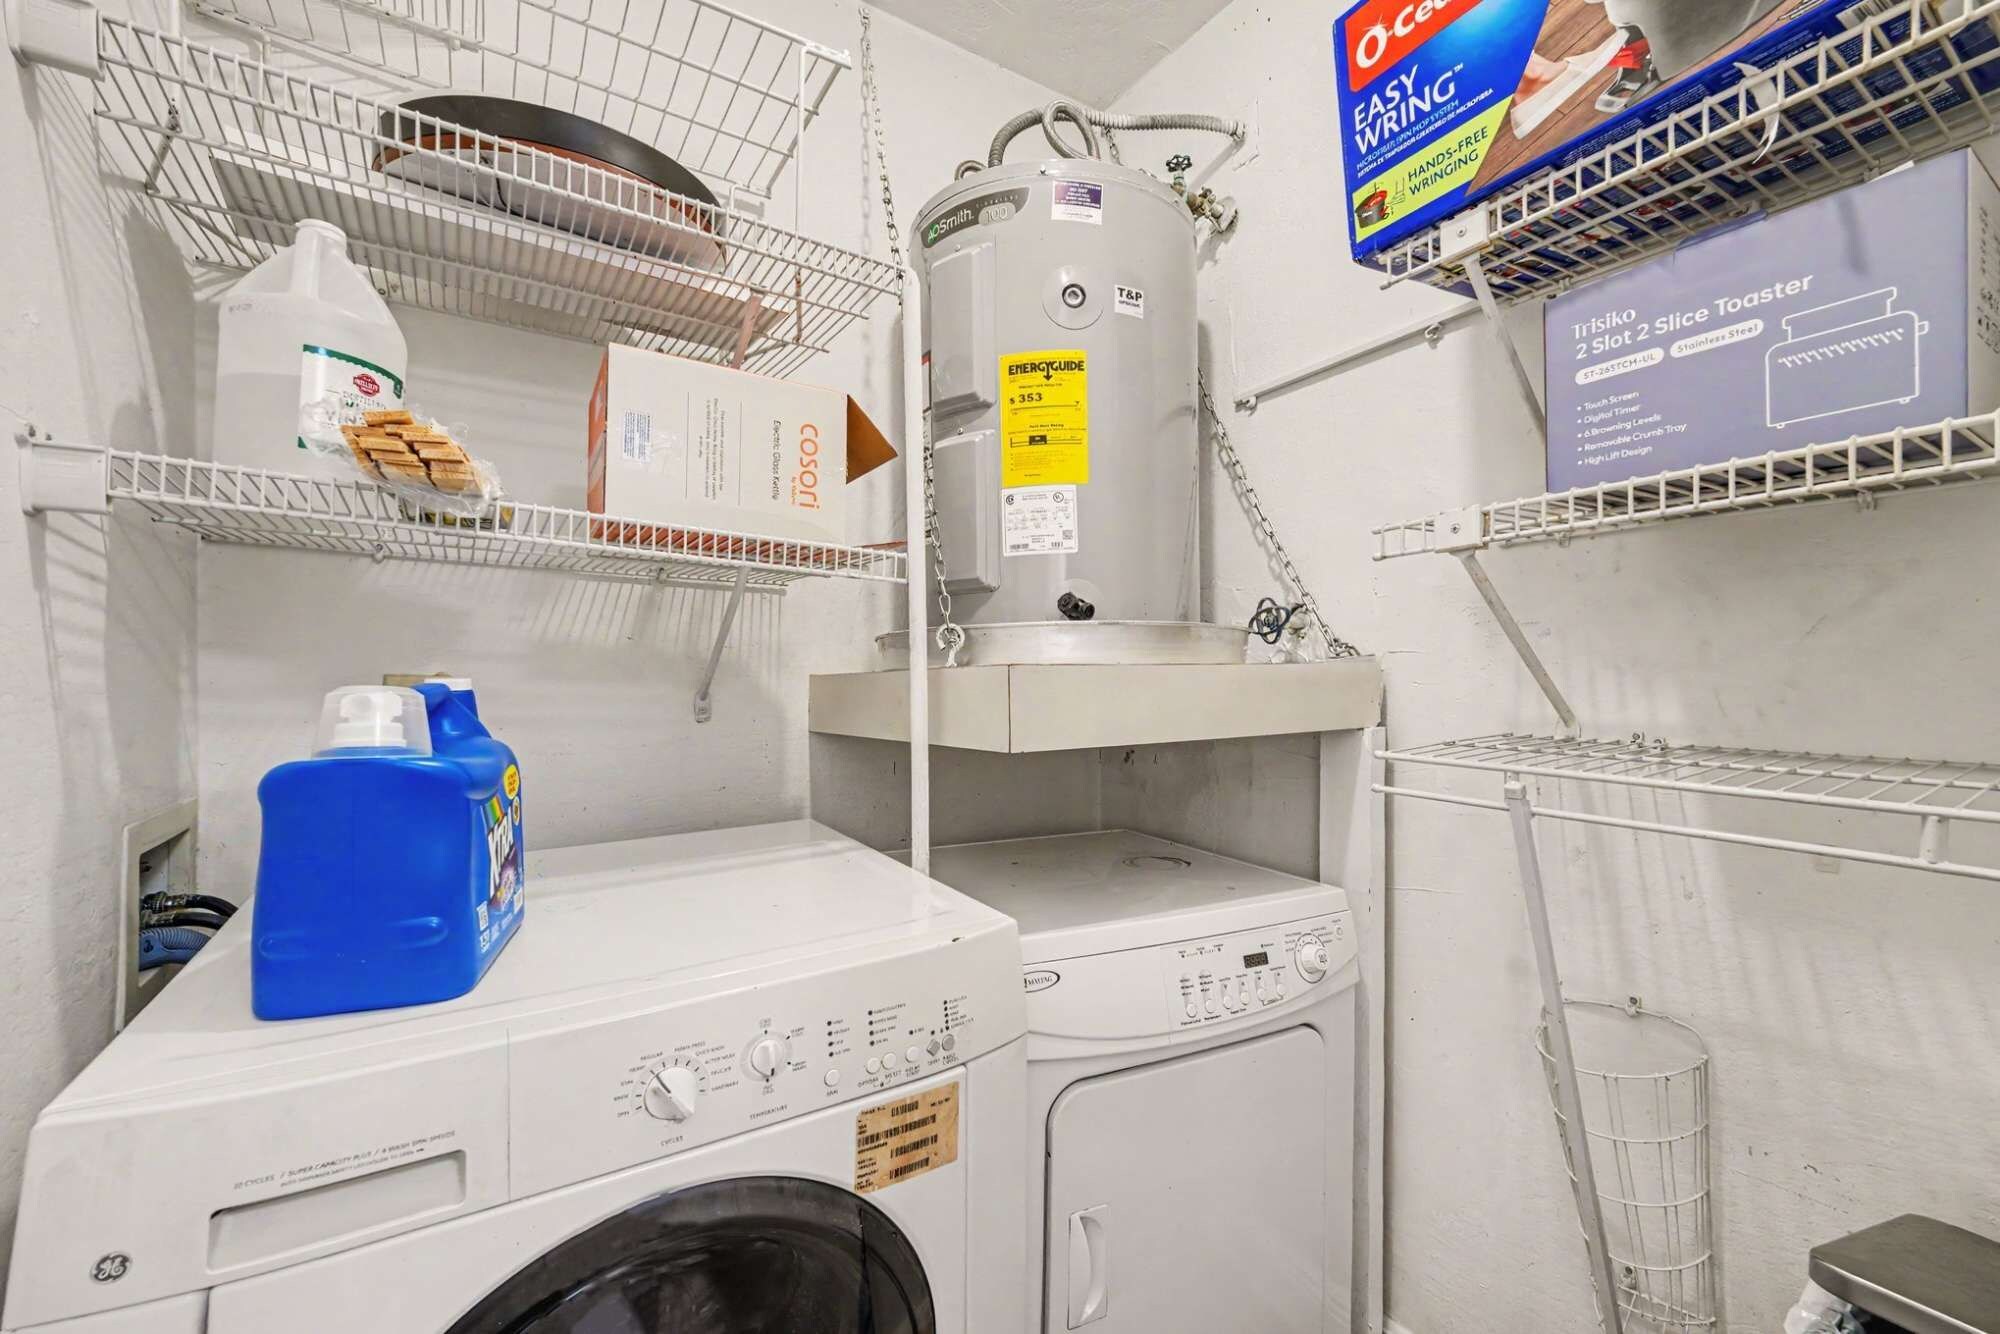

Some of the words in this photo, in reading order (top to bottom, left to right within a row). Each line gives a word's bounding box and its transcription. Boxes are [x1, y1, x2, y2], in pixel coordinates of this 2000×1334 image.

[1354, 64, 1419, 132] EASY
[1412, 118, 1430, 134] MOP
[1408, 126, 1488, 182] HANDS-FREE
[1408, 148, 1479, 196] WRINGING
[1117, 287, 1142, 302] T&P
[1571, 308, 1636, 340] Trisiko
[1576, 343, 1588, 360] 2
[1592, 332, 1632, 356] Slot
[1637, 324, 1650, 342] 2
[1654, 308, 1710, 334] Slice
[1714, 274, 1814, 316] Toaster
[1677, 334, 1726, 354] Stainless
[1728, 324, 1758, 340] Steel
[1008, 360, 1085, 377] ENERGYGUIDE
[1018, 392, 1042, 404] 353
[1584, 398, 1608, 410] Touch
[1608, 392, 1640, 404] Screen
[1584, 410, 1613, 424] Digital
[1614, 404, 1641, 416] Timer
[1591, 420, 1632, 436] Browning
[1632, 414, 1662, 426] Levels
[772, 420, 782, 450] Electric
[1584, 435, 1632, 452] Removable
[1632, 428, 1664, 441] Crumb
[1664, 423, 1688, 434] Tray
[772, 451, 780, 474] Glass
[800, 424, 820, 509] cosori
[1584, 454, 1604, 465] High
[1605, 451, 1620, 462] Lift
[1621, 445, 1652, 458] Design
[772, 475, 780, 500] Kettle
[488, 806, 514, 900] XTRA
